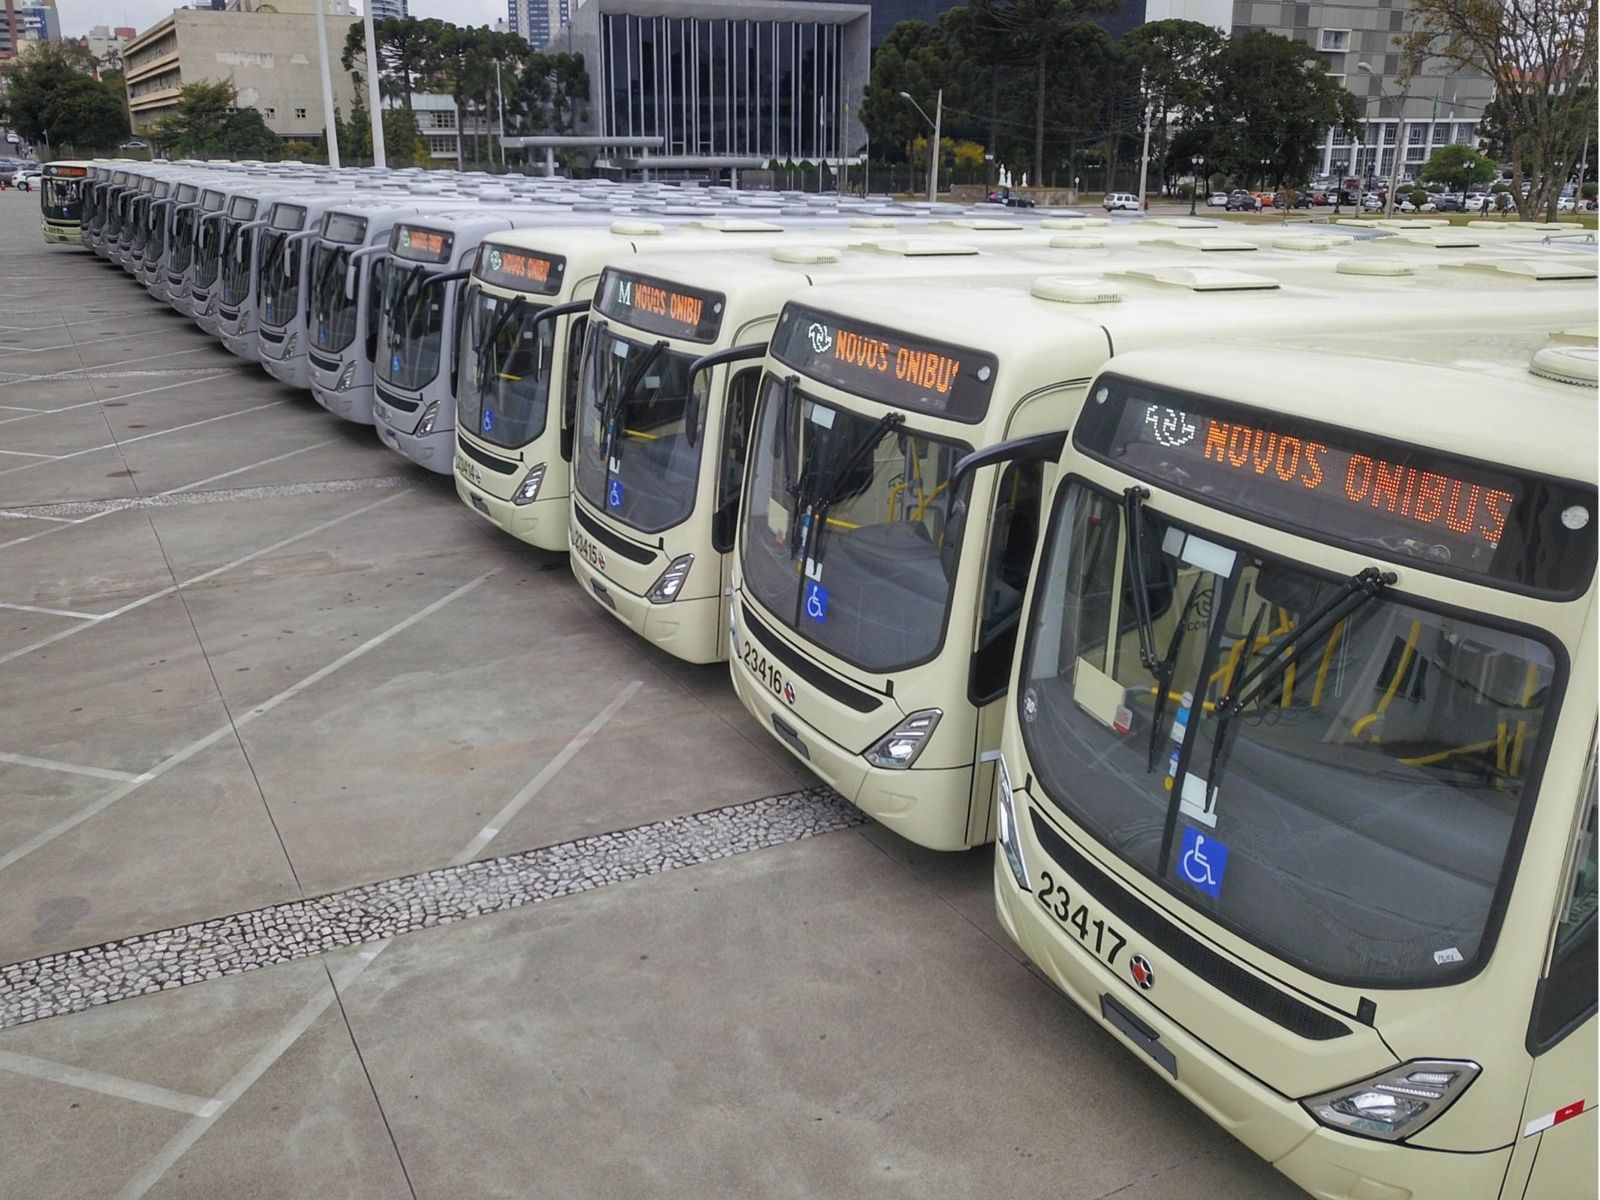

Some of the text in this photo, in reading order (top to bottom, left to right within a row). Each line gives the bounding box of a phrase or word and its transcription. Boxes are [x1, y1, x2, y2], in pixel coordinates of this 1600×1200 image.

[618, 281, 703, 326] M NOVOS ONIBU
[835, 329, 889, 373] NOVOS
[1204, 418, 1515, 543] NOVOS ONIBUS
[744, 641, 782, 694] 23416
[1038, 871, 1127, 965] 23417
